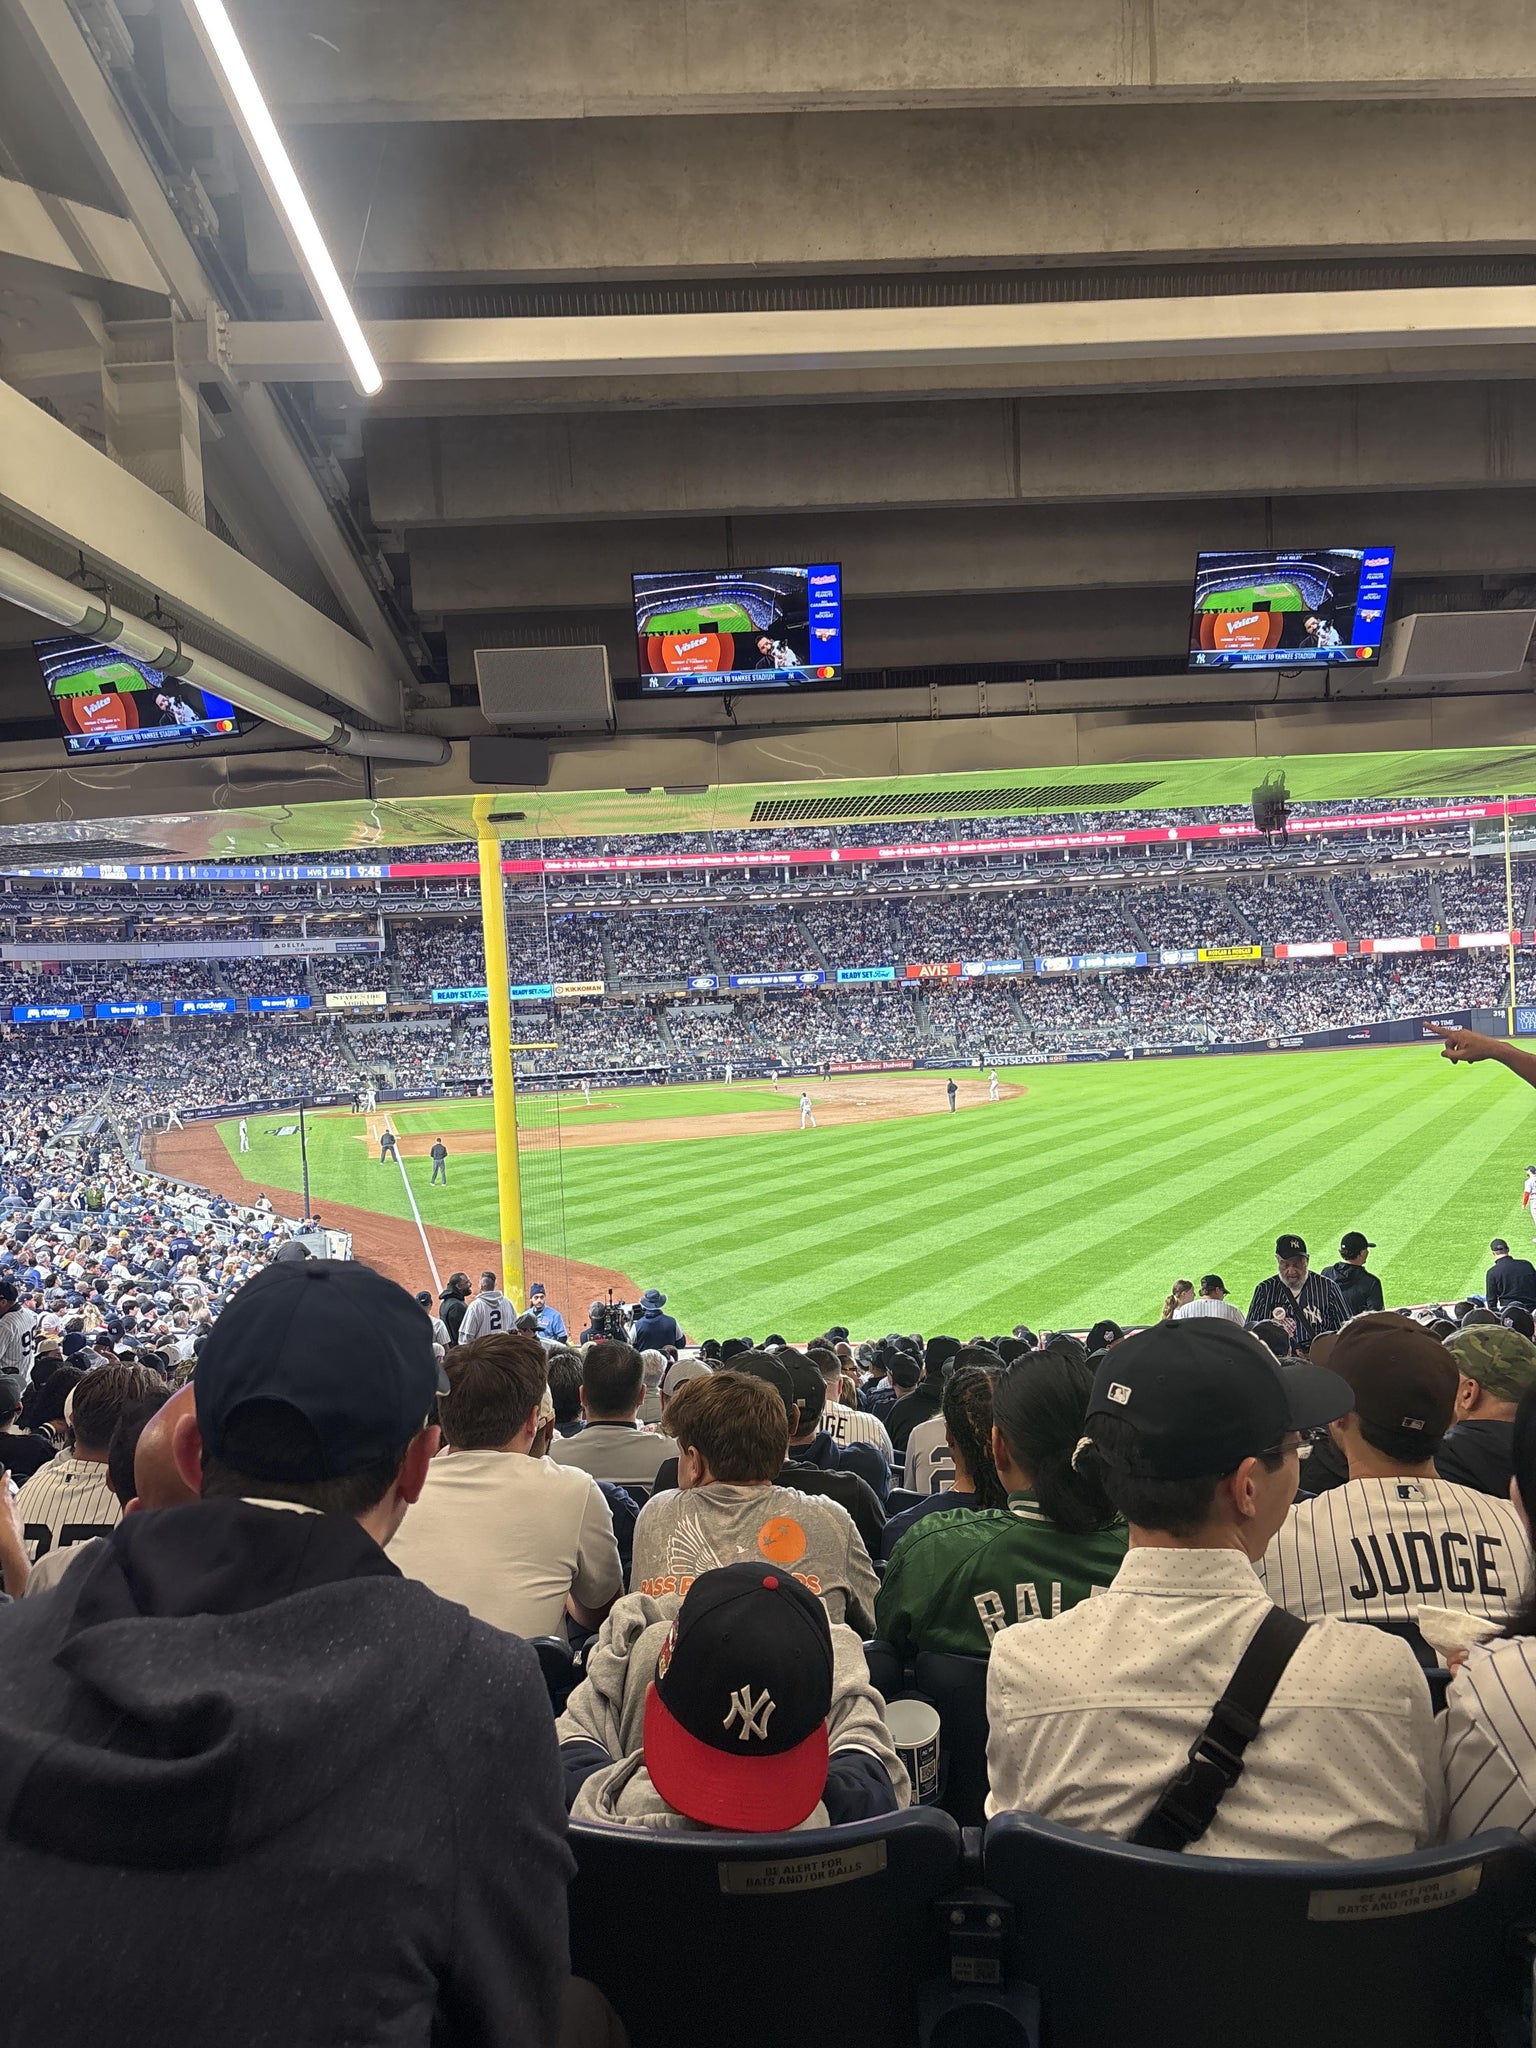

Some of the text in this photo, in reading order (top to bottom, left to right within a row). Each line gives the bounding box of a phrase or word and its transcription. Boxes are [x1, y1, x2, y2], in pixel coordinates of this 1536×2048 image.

[697, 676, 723, 684] WELCOME
[752, 673, 775, 681] STADIUM
[111, 734, 135, 743] WELCOME
[141, 732, 159, 740] YANKEE
[1355, 817, 1385, 825] Covenant
[1464, 808, 1486, 816] Jersey
[931, 846, 943, 854] Play
[1036, 838, 1053, 846] House
[598, 860, 610, 869] Play
[772, 853, 791, 861] Jersey
[203, 869, 209, 877] 6
[215, 869, 221, 877] 7
[228, 869, 234, 877] 8
[240, 869, 246, 877] 9
[357, 866, 381, 877] 9:45
[841, 971, 861, 980] READY
[862, 971, 872, 979] SET
[920, 965, 949, 976] AVIS
[437, 991, 472, 1000] READY SET
[196, 1001, 227, 1011] roadway
[262, 999, 271, 1007] We
[41, 1007, 70, 1017] roadway
[111, 1006, 119, 1014] We
[984, 1055, 1048, 1066] POSTSEASON
[851, 1061, 913, 1072] Budweiser Budweiser
[1290, 1239, 1300, 1249] NY
[1303, 1304, 1323, 1324] NY
[490, 1310, 501, 1331] 2
[1350, 1531, 1507, 1600] JUDGE
[723, 1684, 776, 1741] NY
[765, 1857, 843, 1877] BE ALERT FOR
[746, 1862, 862, 1888] BATS AND/OR BALLS
[1359, 1882, 1440, 1903] BE ALERT FOR
[1337, 1904, 1369, 1915] BATS
[1423, 1889, 1457, 1903] BALLS
